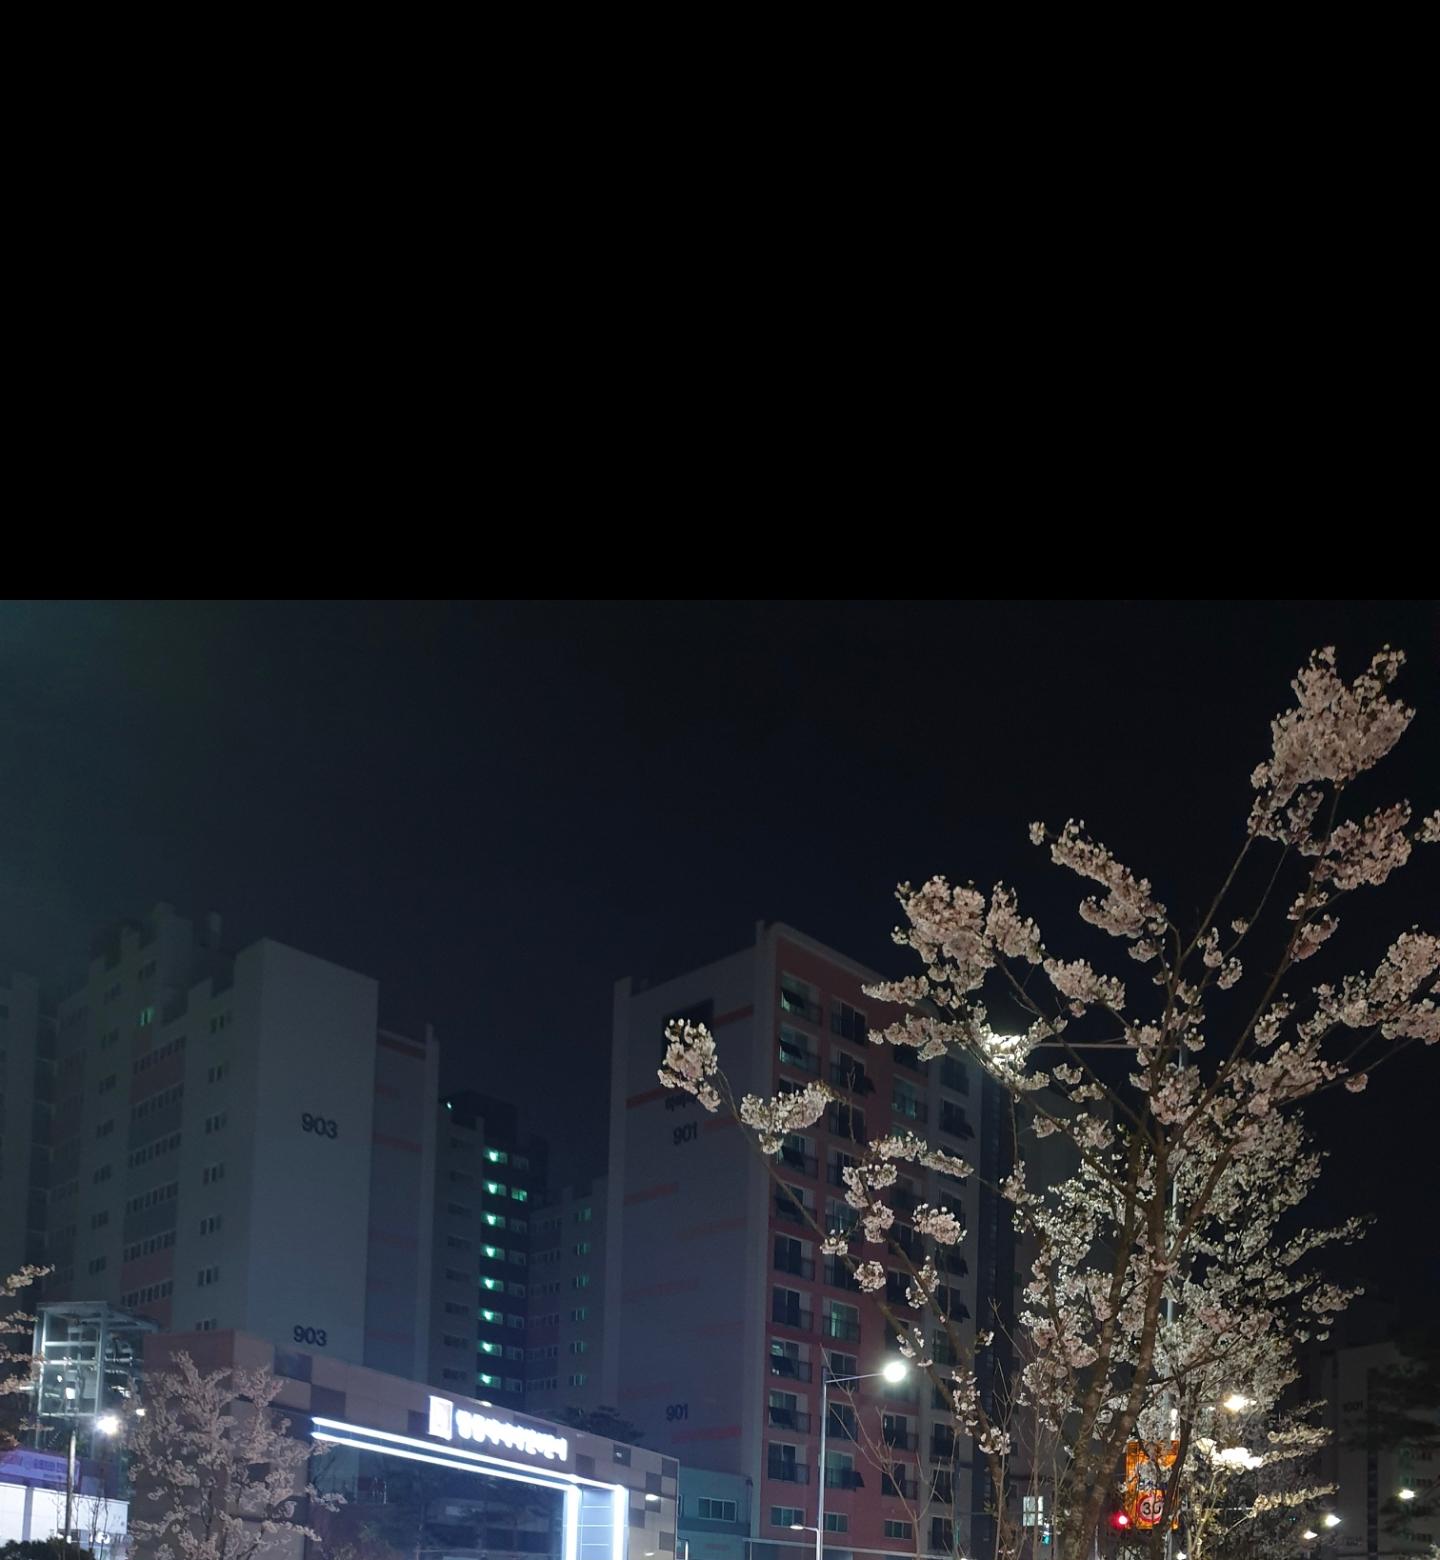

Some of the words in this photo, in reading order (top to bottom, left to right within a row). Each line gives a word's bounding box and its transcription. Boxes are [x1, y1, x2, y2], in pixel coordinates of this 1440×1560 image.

[301, 1113, 338, 1139] 903
[673, 1121, 698, 1145] 901
[293, 1325, 327, 1347] 903
[666, 1404, 688, 1422] 901
[1142, 1501, 1162, 1515] 30
